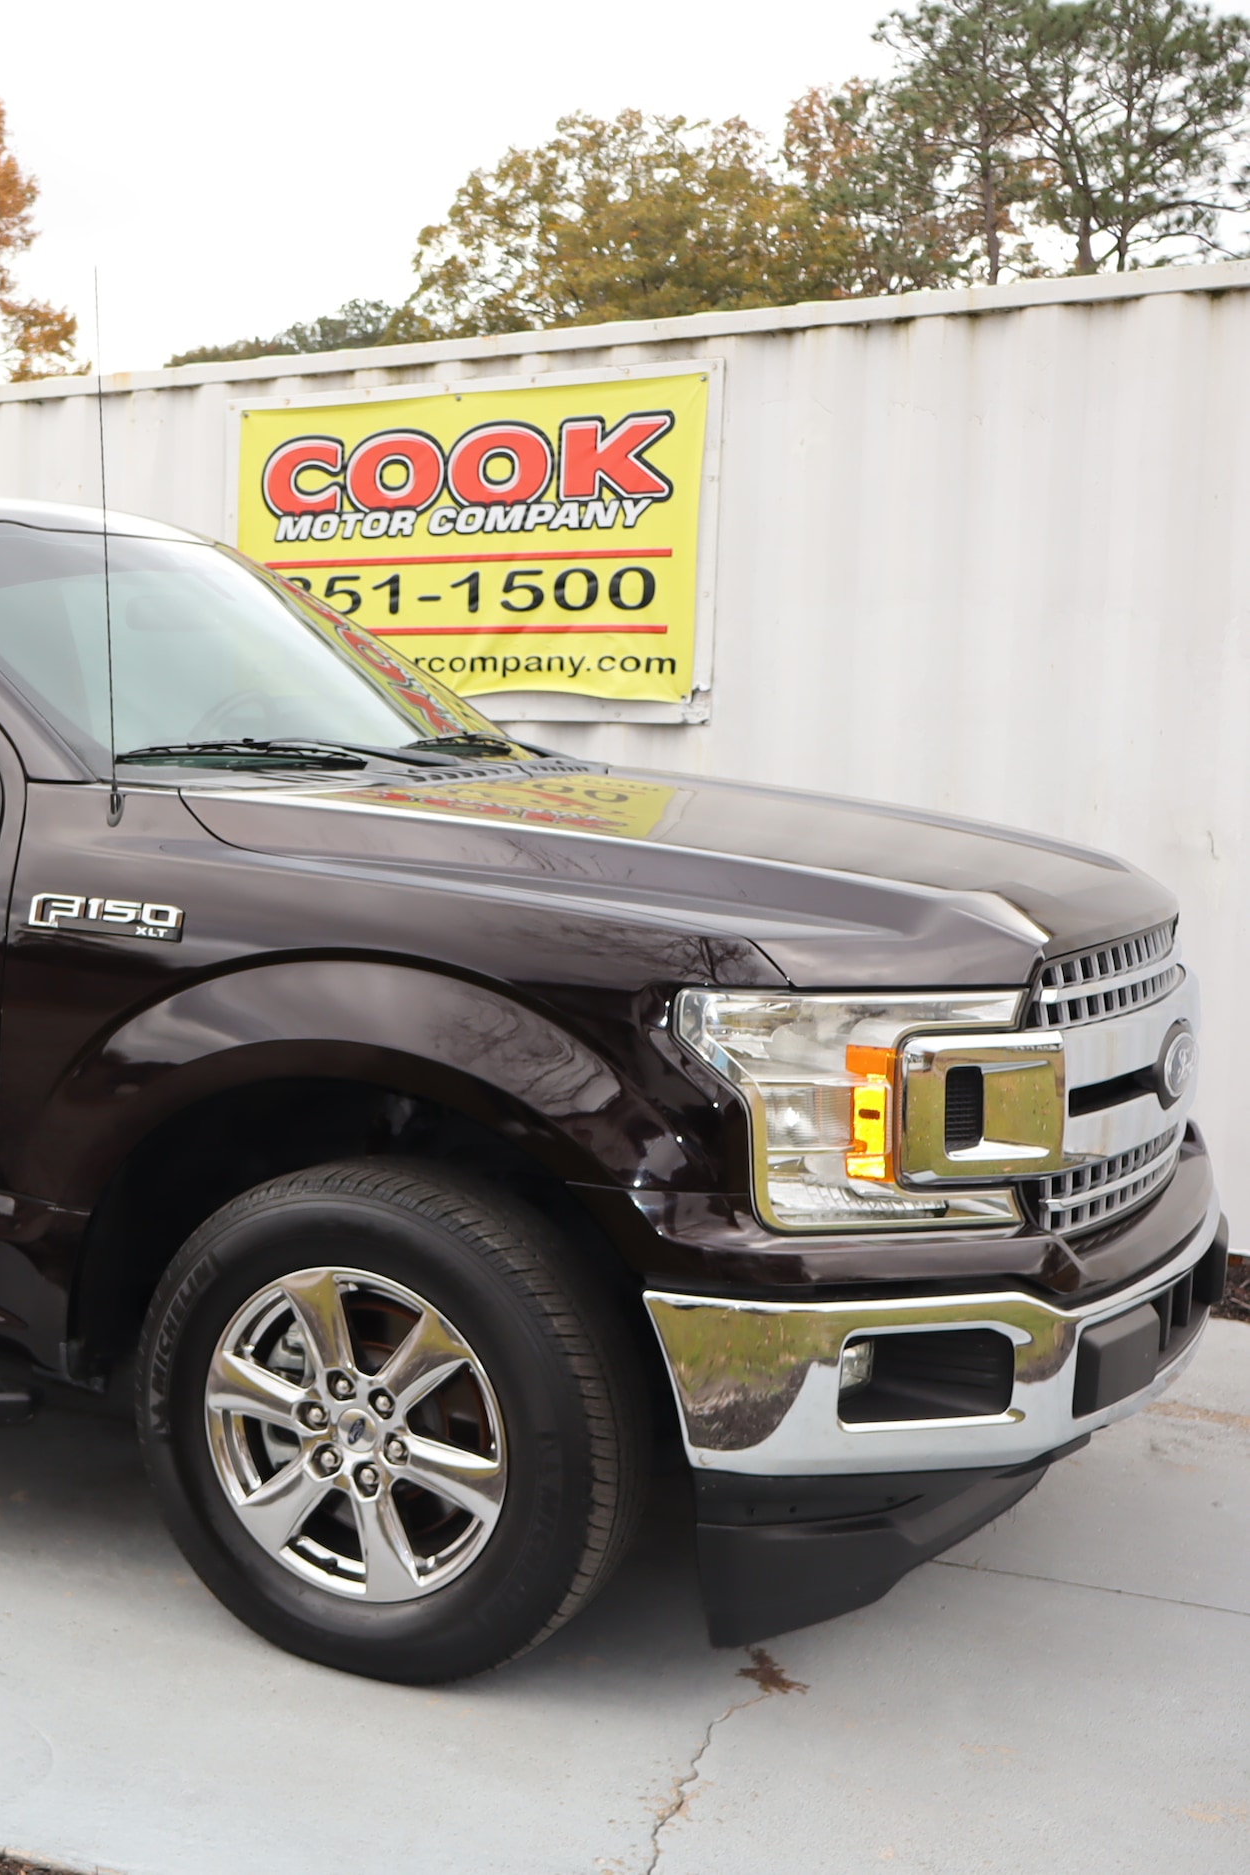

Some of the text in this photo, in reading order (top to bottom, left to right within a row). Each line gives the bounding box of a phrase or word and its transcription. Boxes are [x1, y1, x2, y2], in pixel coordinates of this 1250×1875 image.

[261, 410, 675, 517] COOK
[274, 497, 654, 542] MOTOR COMPANY
[135, 926, 168, 938] XLT
[151, 1256, 211, 1396] MICHELIN
